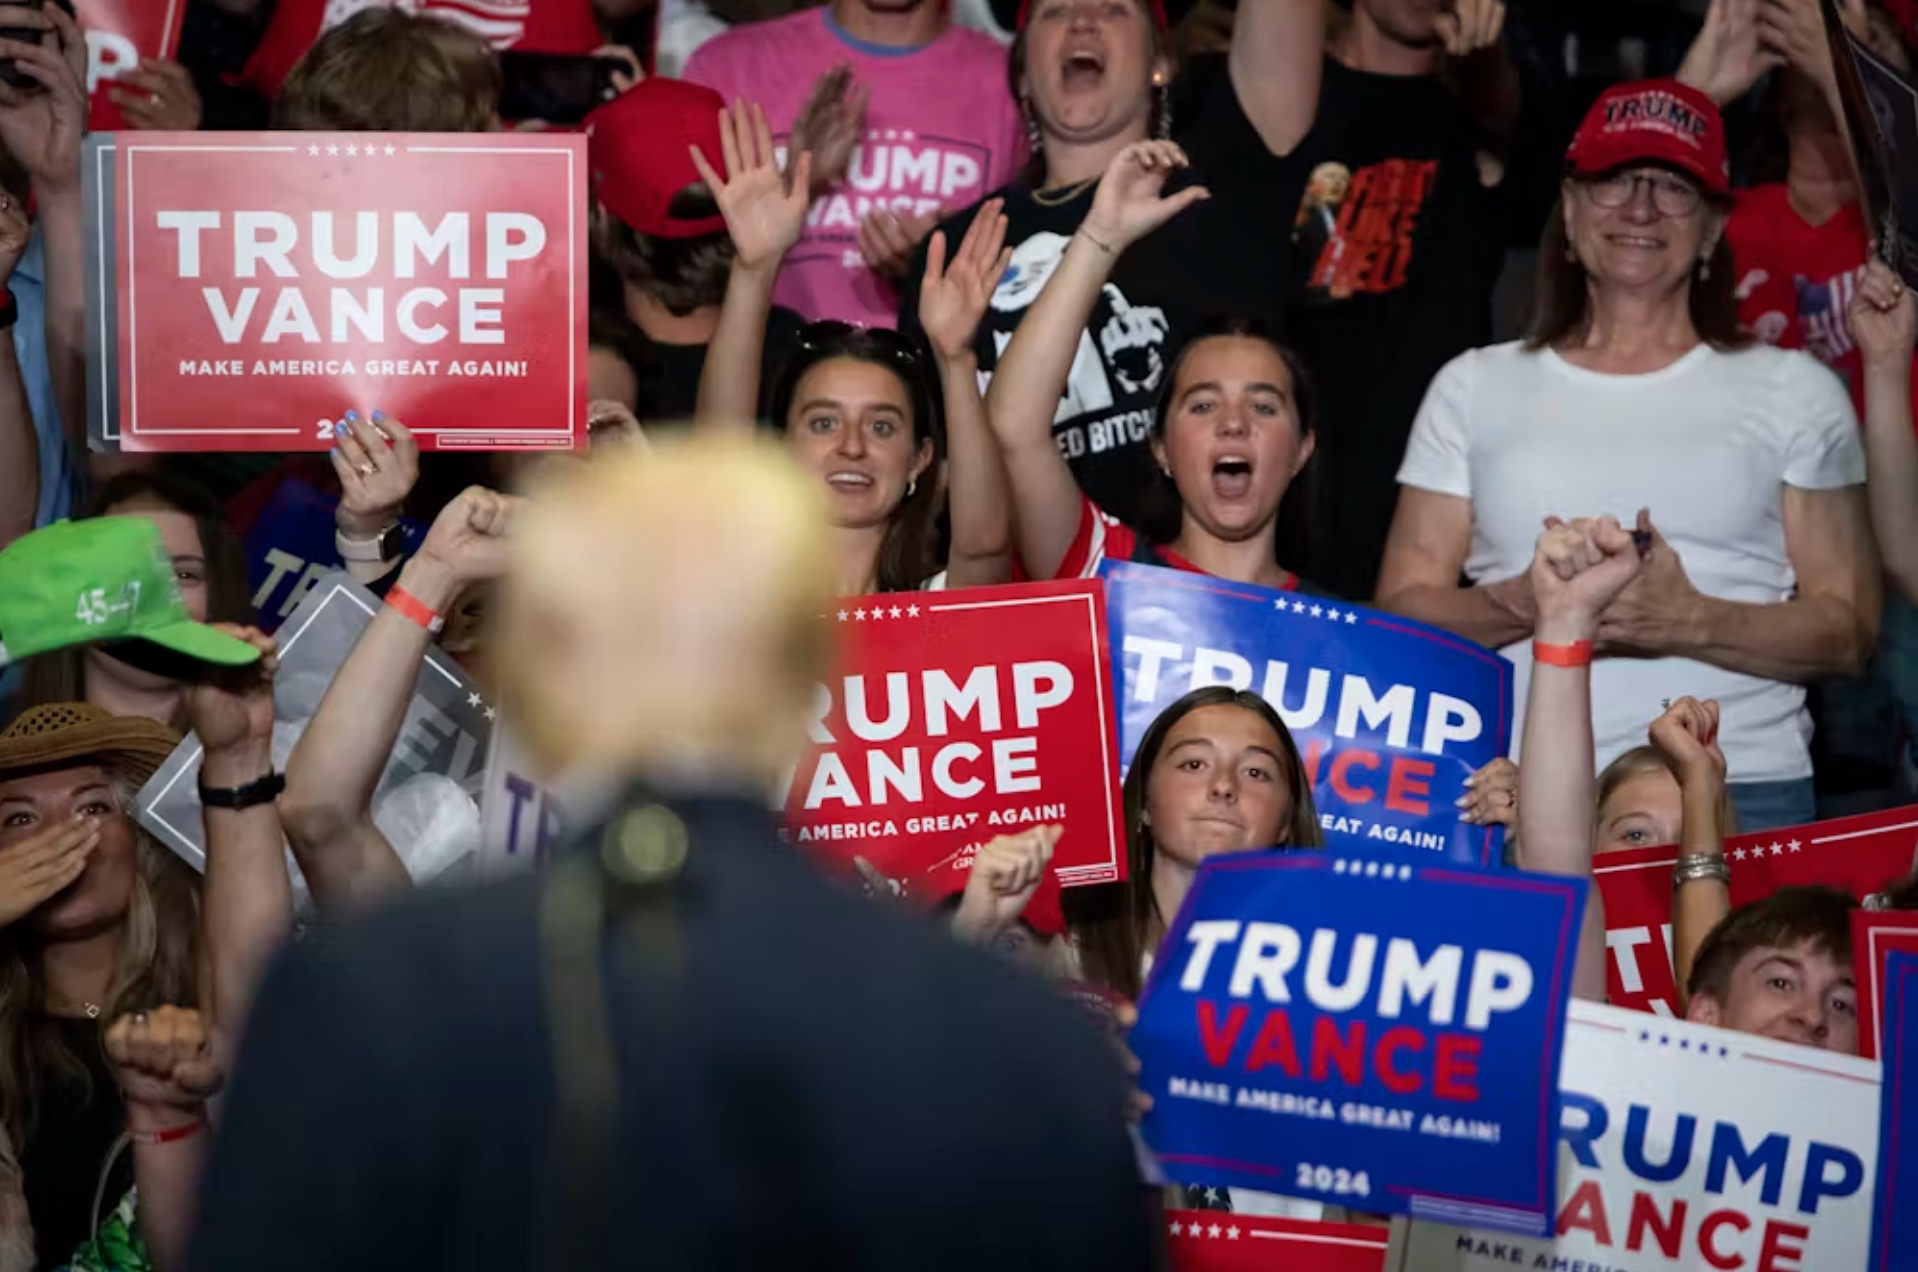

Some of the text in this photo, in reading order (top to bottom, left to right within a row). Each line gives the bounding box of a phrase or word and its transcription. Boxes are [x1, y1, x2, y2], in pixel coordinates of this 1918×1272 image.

[1605, 97, 1706, 137] TRUMP
[774, 146, 979, 196] UMP
[156, 210, 548, 279] TRUMP
[202, 287, 506, 345] VANCE
[179, 360, 528, 377] MAKE AMERICA GREAT AGAIN!
[806, 660, 1075, 744] RUMP
[1122, 635, 1483, 756] TRUMP
[798, 818, 899, 842] AMERICA
[905, 812, 979, 835] GREAT
[987, 803, 1067, 827] AGAIN!
[1320, 813, 1446, 851] EAT AGAIN!
[1180, 919, 1534, 1030] TRUMP
[1197, 1001, 1483, 1101] VANCE
[1168, 1076, 1502, 1144] MAKE AMERICA GREAT AGAIN!
[1296, 1162, 1371, 1197] 2024
[1558, 1089, 1866, 1216] RUMP
[1456, 1235, 1636, 1272] MAKE AMER
[1555, 1179, 1811, 1272] ANCE
